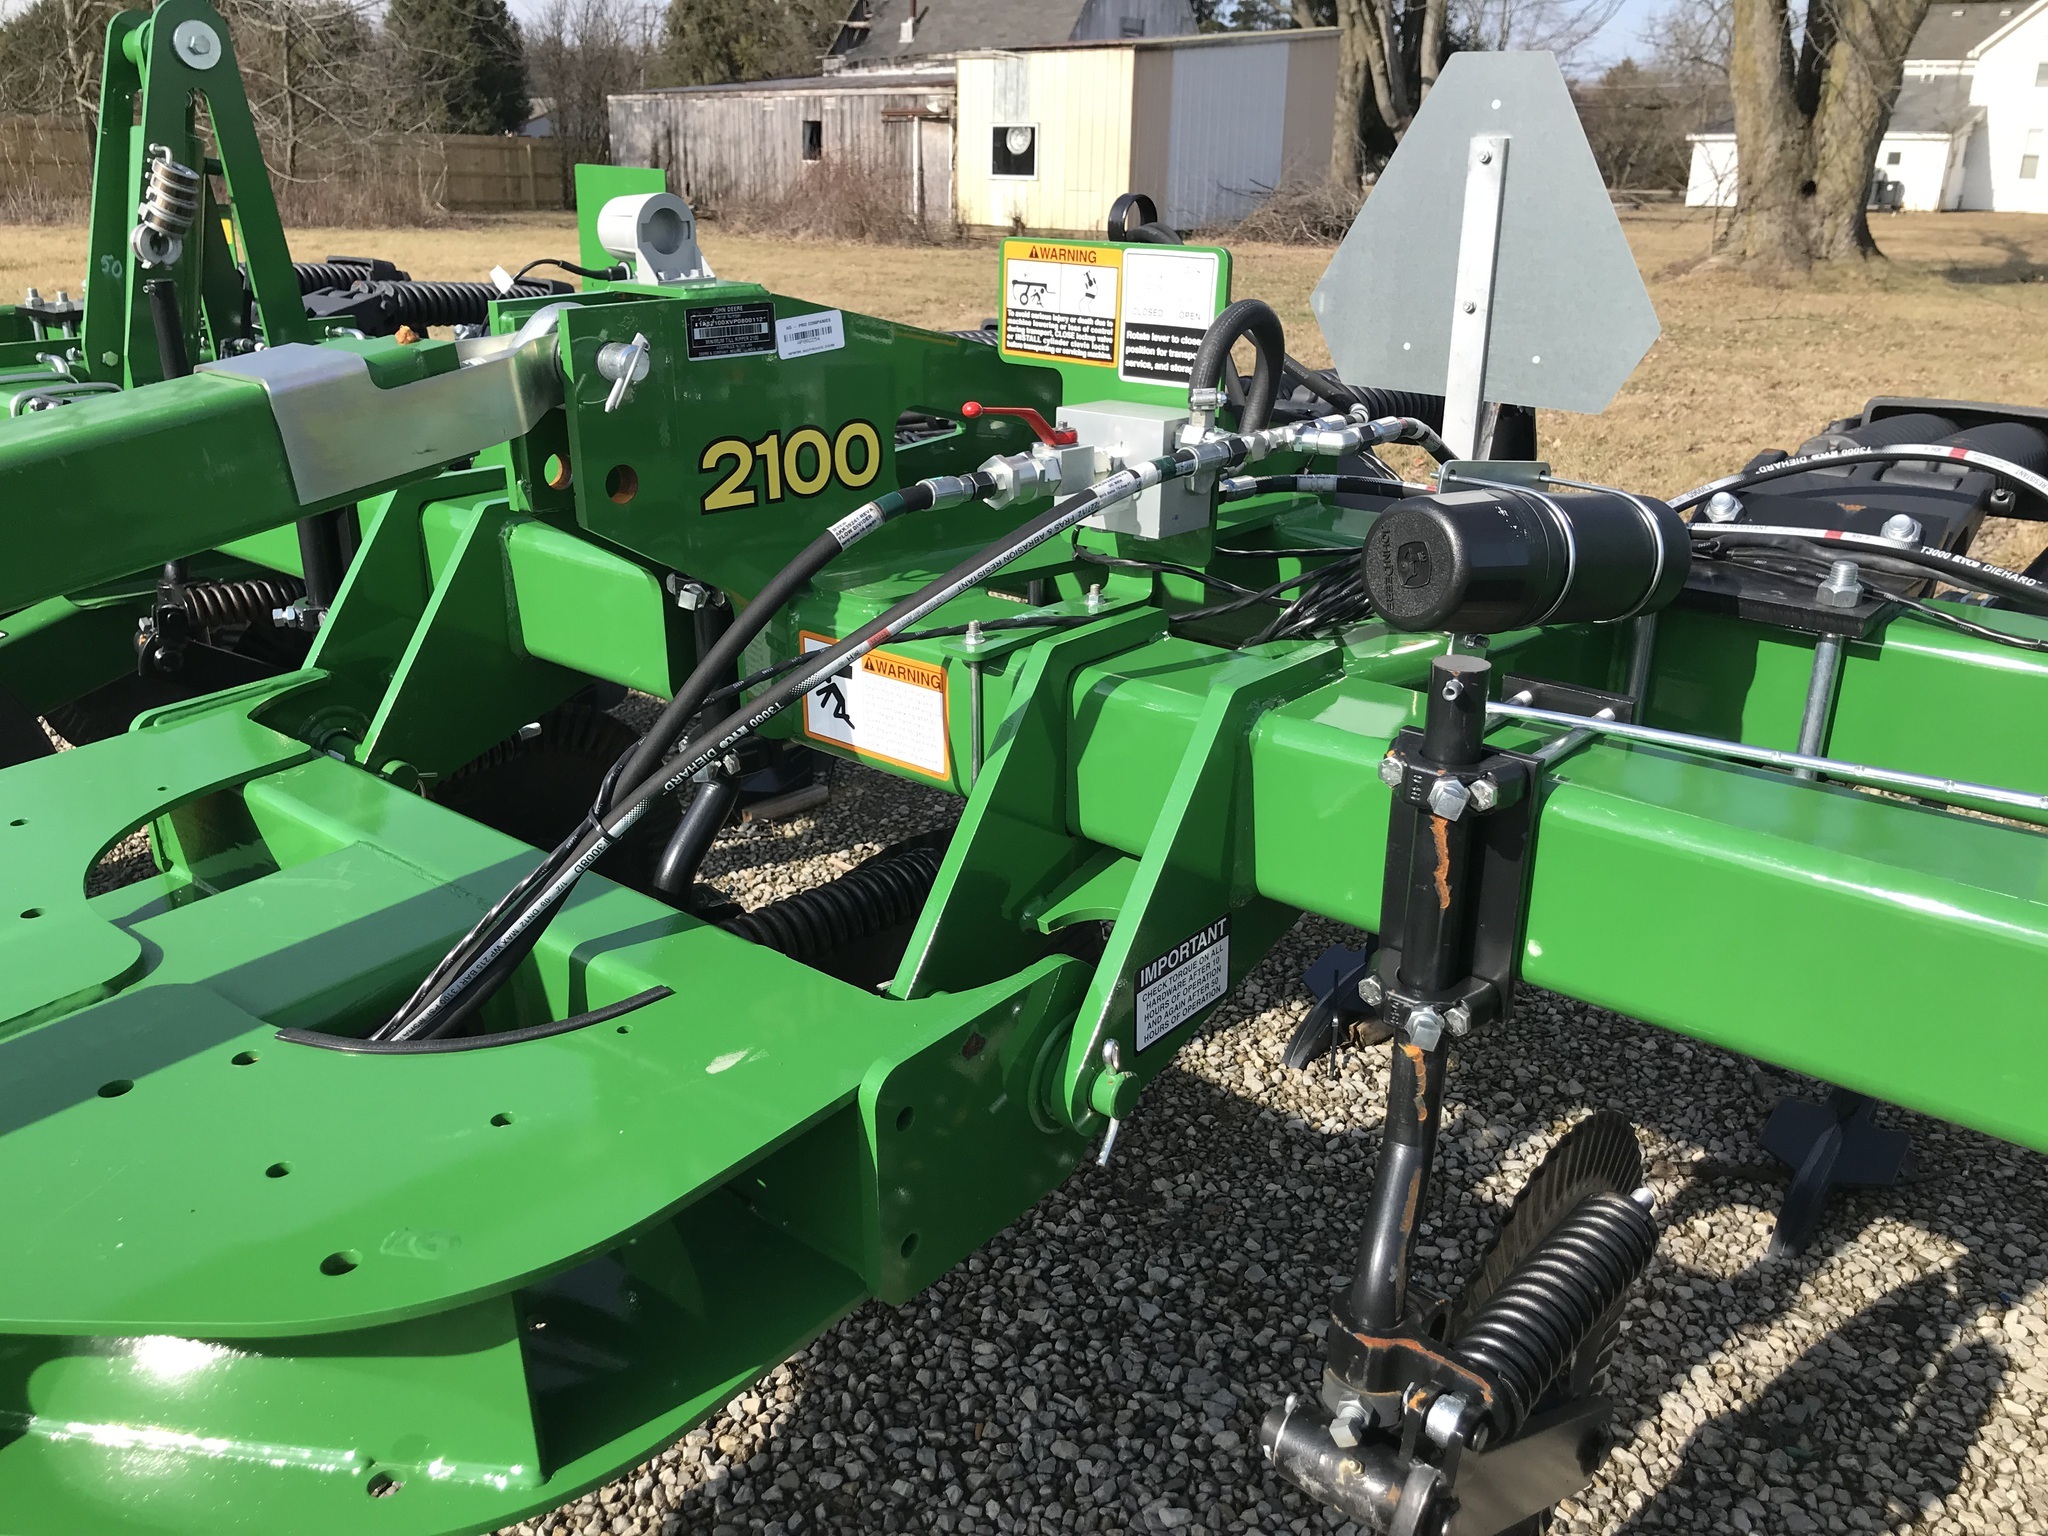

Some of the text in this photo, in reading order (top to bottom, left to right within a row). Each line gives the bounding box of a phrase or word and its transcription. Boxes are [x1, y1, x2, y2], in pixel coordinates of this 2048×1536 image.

[1040, 247, 1097, 263] WARNING
[100, 254, 122, 278] 50
[808, 318, 831, 326] COMPANIES
[1007, 308, 1014, 316] To
[1015, 310, 1030, 318] avoid
[1031, 312, 1052, 320] serious
[1052, 314, 1069, 324] injury
[1077, 316, 1094, 325] death
[1094, 318, 1106, 326] due
[1132, 307, 1201, 320] CLOSED OPEN
[1007, 318, 1032, 326] machine
[1033, 320, 1058, 331] lowering
[1090, 327, 1113, 335] control
[1007, 326, 1026, 336] during
[1054, 330, 1075, 340] CLOSE
[1076, 333, 1096, 342] lockup
[1015, 333, 1042, 343] INSTALL
[1042, 338, 1070, 347] cylinder
[1070, 340, 1090, 349] clevis
[1091, 342, 1110, 351] locks
[1126, 330, 1203, 346] Rotate lever to close
[1125, 345, 1155, 356] position
[1156, 347, 1168, 357] for
[1125, 359, 1154, 370] service,
[1154, 362, 1169, 371] and
[1170, 364, 1193, 375] storag
[1841, 446, 1872, 456] T3000
[700, 420, 882, 513] 2100
[2014, 469, 2047, 490] RESISTANT
[838, 515, 872, 540] FLOW DIVIDER
[1054, 518, 1075, 533] FRAS
[1005, 534, 1046, 561] ABRASION
[1920, 546, 1951, 559] T3000
[957, 560, 1002, 592] RESISTANT
[1381, 526, 1394, 610] JOHN DEERE
[875, 659, 941, 690] WARNING
[749, 702, 785, 728] T3000
[520, 908, 540, 927] DN12
[501, 928, 520, 945] MAX
[490, 944, 504, 958] WP
[1140, 917, 1227, 988] IMPORTANT
[476, 956, 490, 970] 215
[460, 970, 478, 985] BAR
[1142, 944, 1224, 1002] CHECK TORQUE ON ALL
[1146, 956, 1220, 1010] HARDWARE AFTER 10
[440, 988, 458, 1005] 3100
[1144, 964, 1221, 1022] HOURS OF OPERATION
[426, 1004, 441, 1017] PSI
[1147, 976, 1219, 1031] AND AGAIN AFTER 50
[1143, 985, 1221, 1043] HOURS OF OPERATION
[402, 1016, 427, 1037] MSHA
